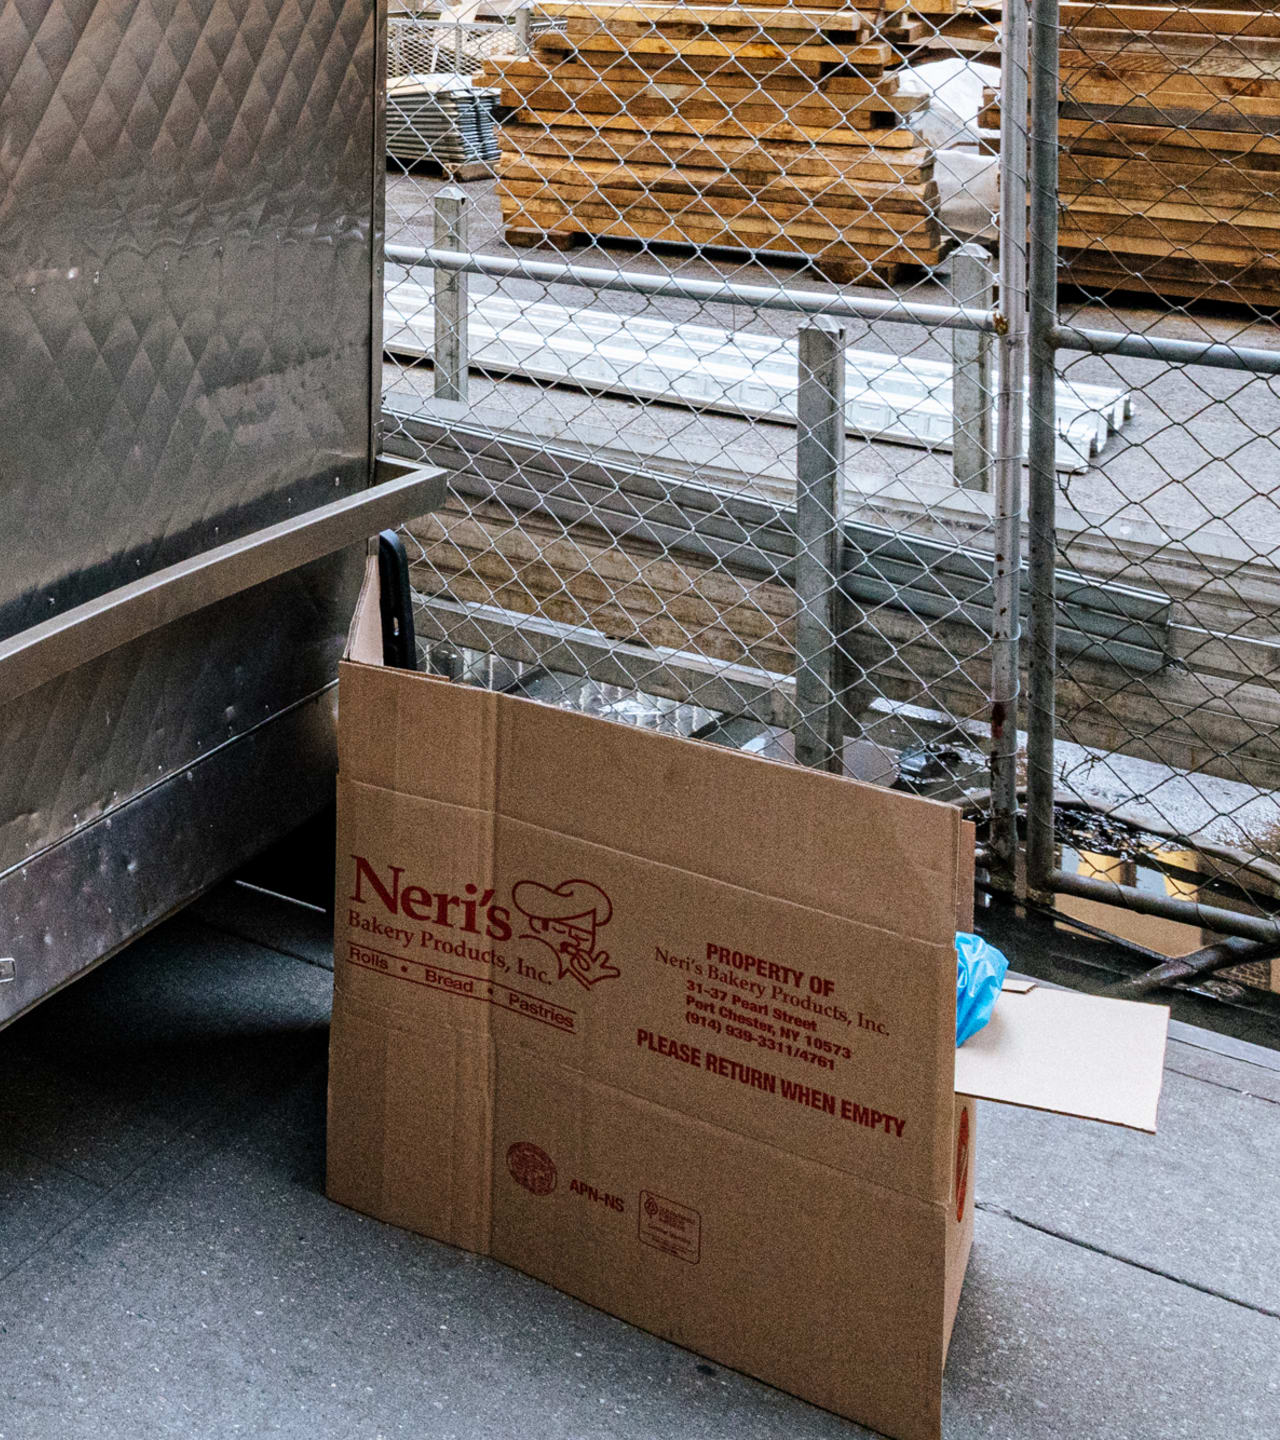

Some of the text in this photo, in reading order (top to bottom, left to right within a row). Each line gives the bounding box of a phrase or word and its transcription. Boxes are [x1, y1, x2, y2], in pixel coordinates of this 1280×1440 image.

[349, 854, 513, 942] Neri's
[348, 910, 552, 986] Bakery Products, Inc.
[706, 942, 836, 997] PROPERTY OF
[349, 946, 575, 1029] Rolls Bread Pastries
[654, 946, 891, 1037] Neri's Bakery Products, Inc.
[686, 980, 818, 1033] 31-37 Pearl Street
[685, 1011, 722, 1035] (914)
[686, 995, 852, 1060] Port Chester, NY 10573
[637, 1028, 906, 1138] PLEASE RETURN WHEN EMPTY
[569, 1178, 625, 1213] APN-NS
